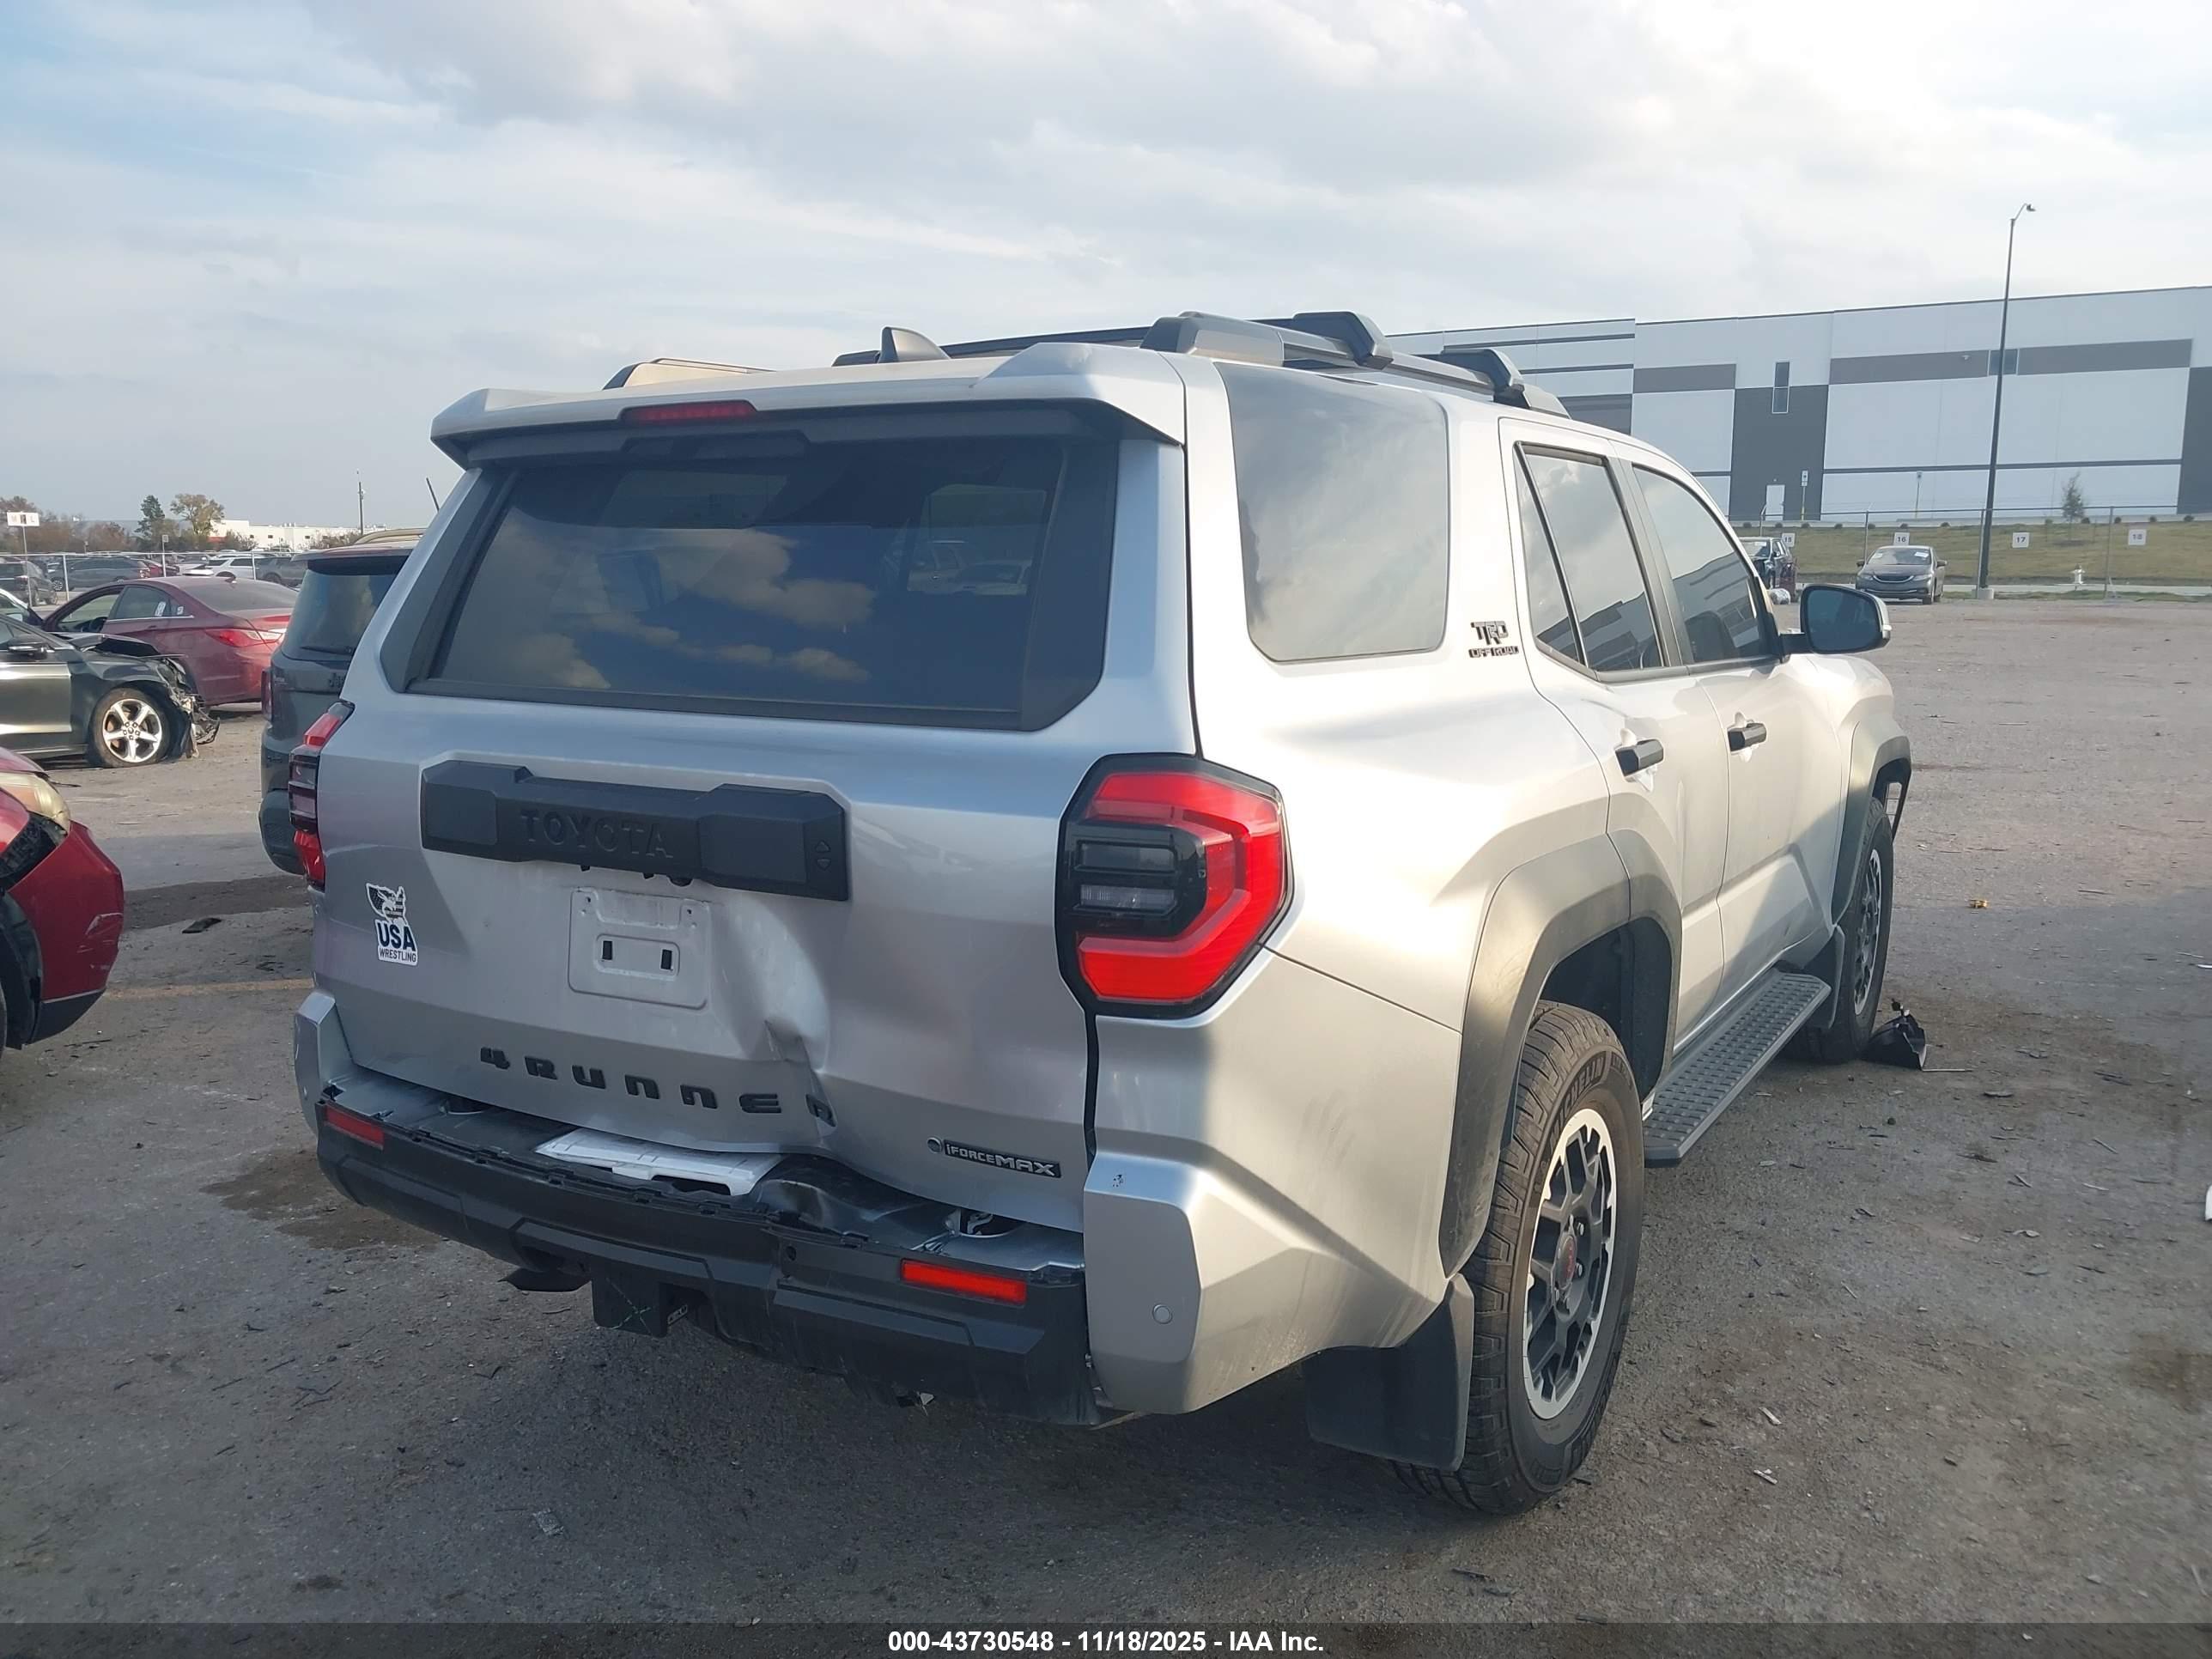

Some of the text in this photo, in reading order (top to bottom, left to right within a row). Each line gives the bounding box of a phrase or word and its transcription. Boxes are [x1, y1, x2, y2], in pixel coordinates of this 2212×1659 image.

[1470, 621, 1509, 645] TRD
[520, 808, 674, 860] TOYOTA
[377, 922, 416, 951] USA
[379, 947, 416, 963] WRESTLING
